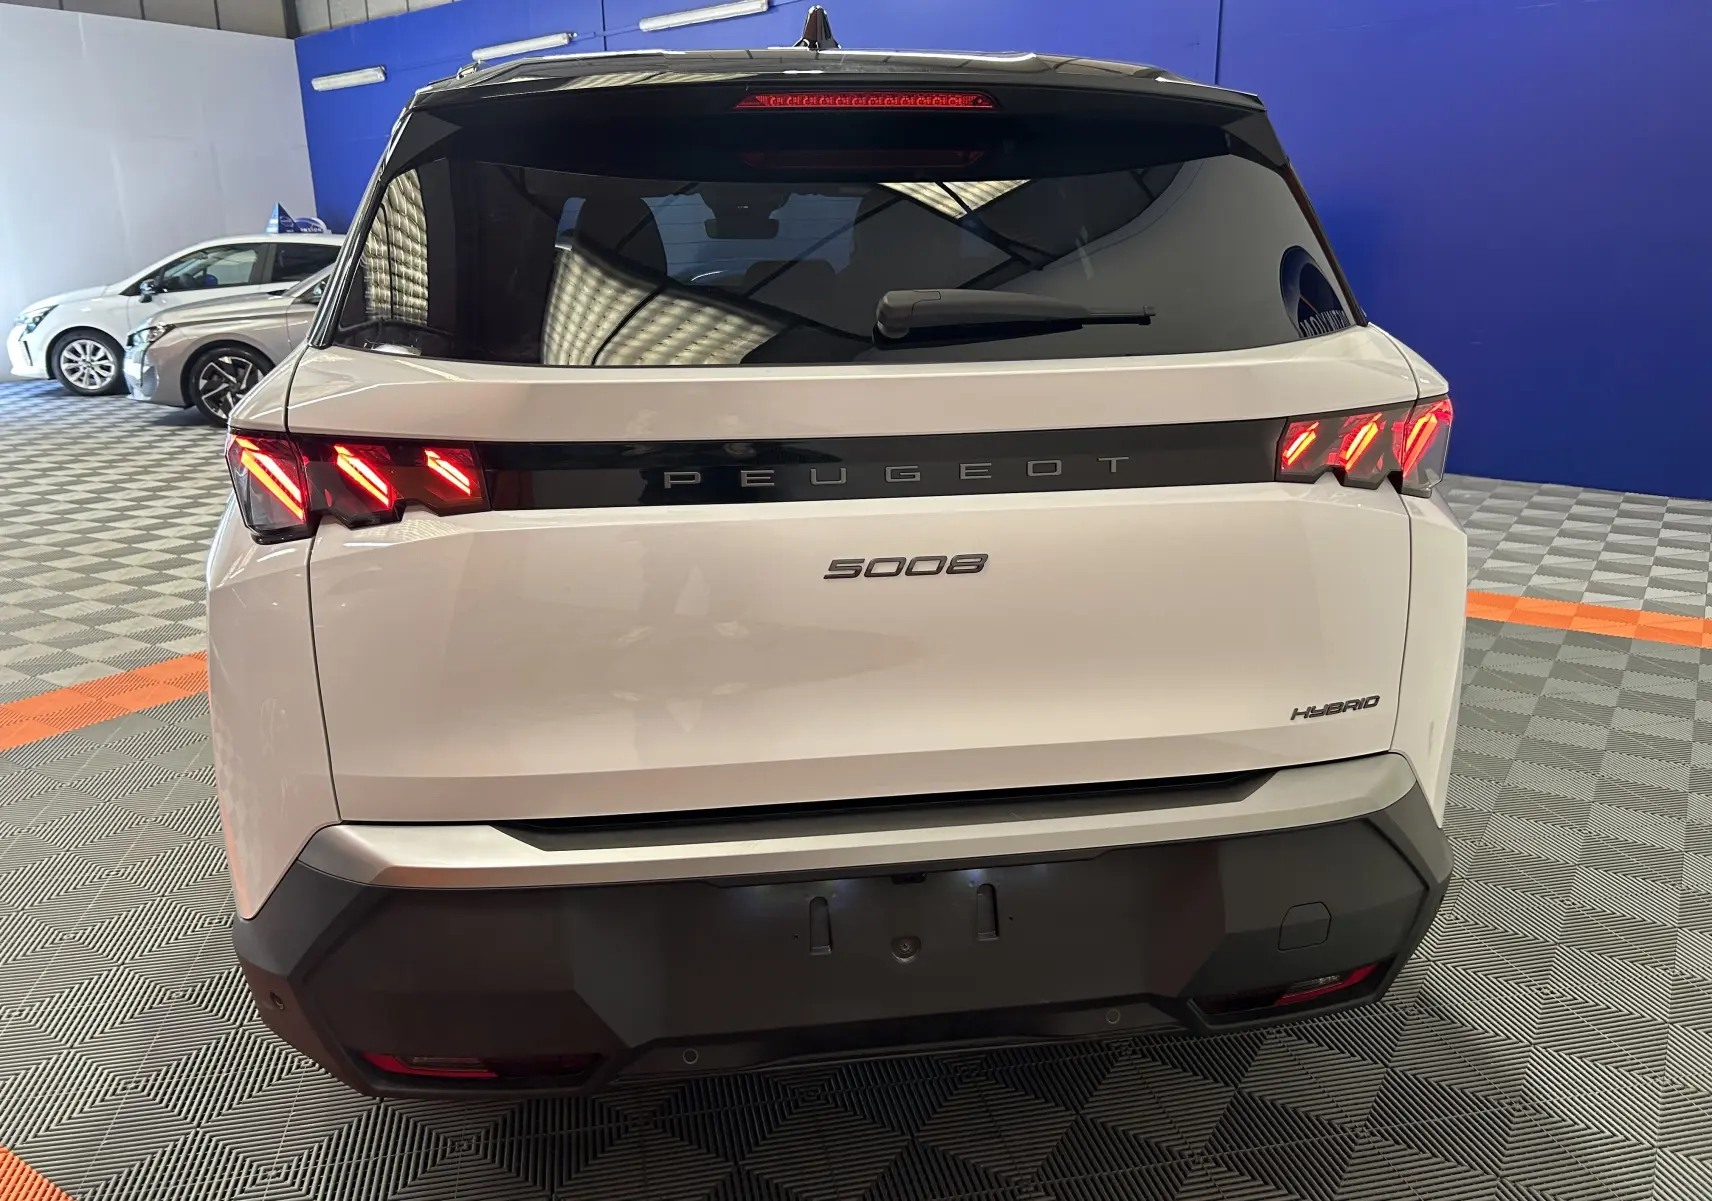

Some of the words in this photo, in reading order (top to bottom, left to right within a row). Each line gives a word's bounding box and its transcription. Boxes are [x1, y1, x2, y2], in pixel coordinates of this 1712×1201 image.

[663, 456, 1130, 489] PEUGEOT
[823, 553, 989, 580] 5008
[1290, 695, 1381, 721] HYBRID
